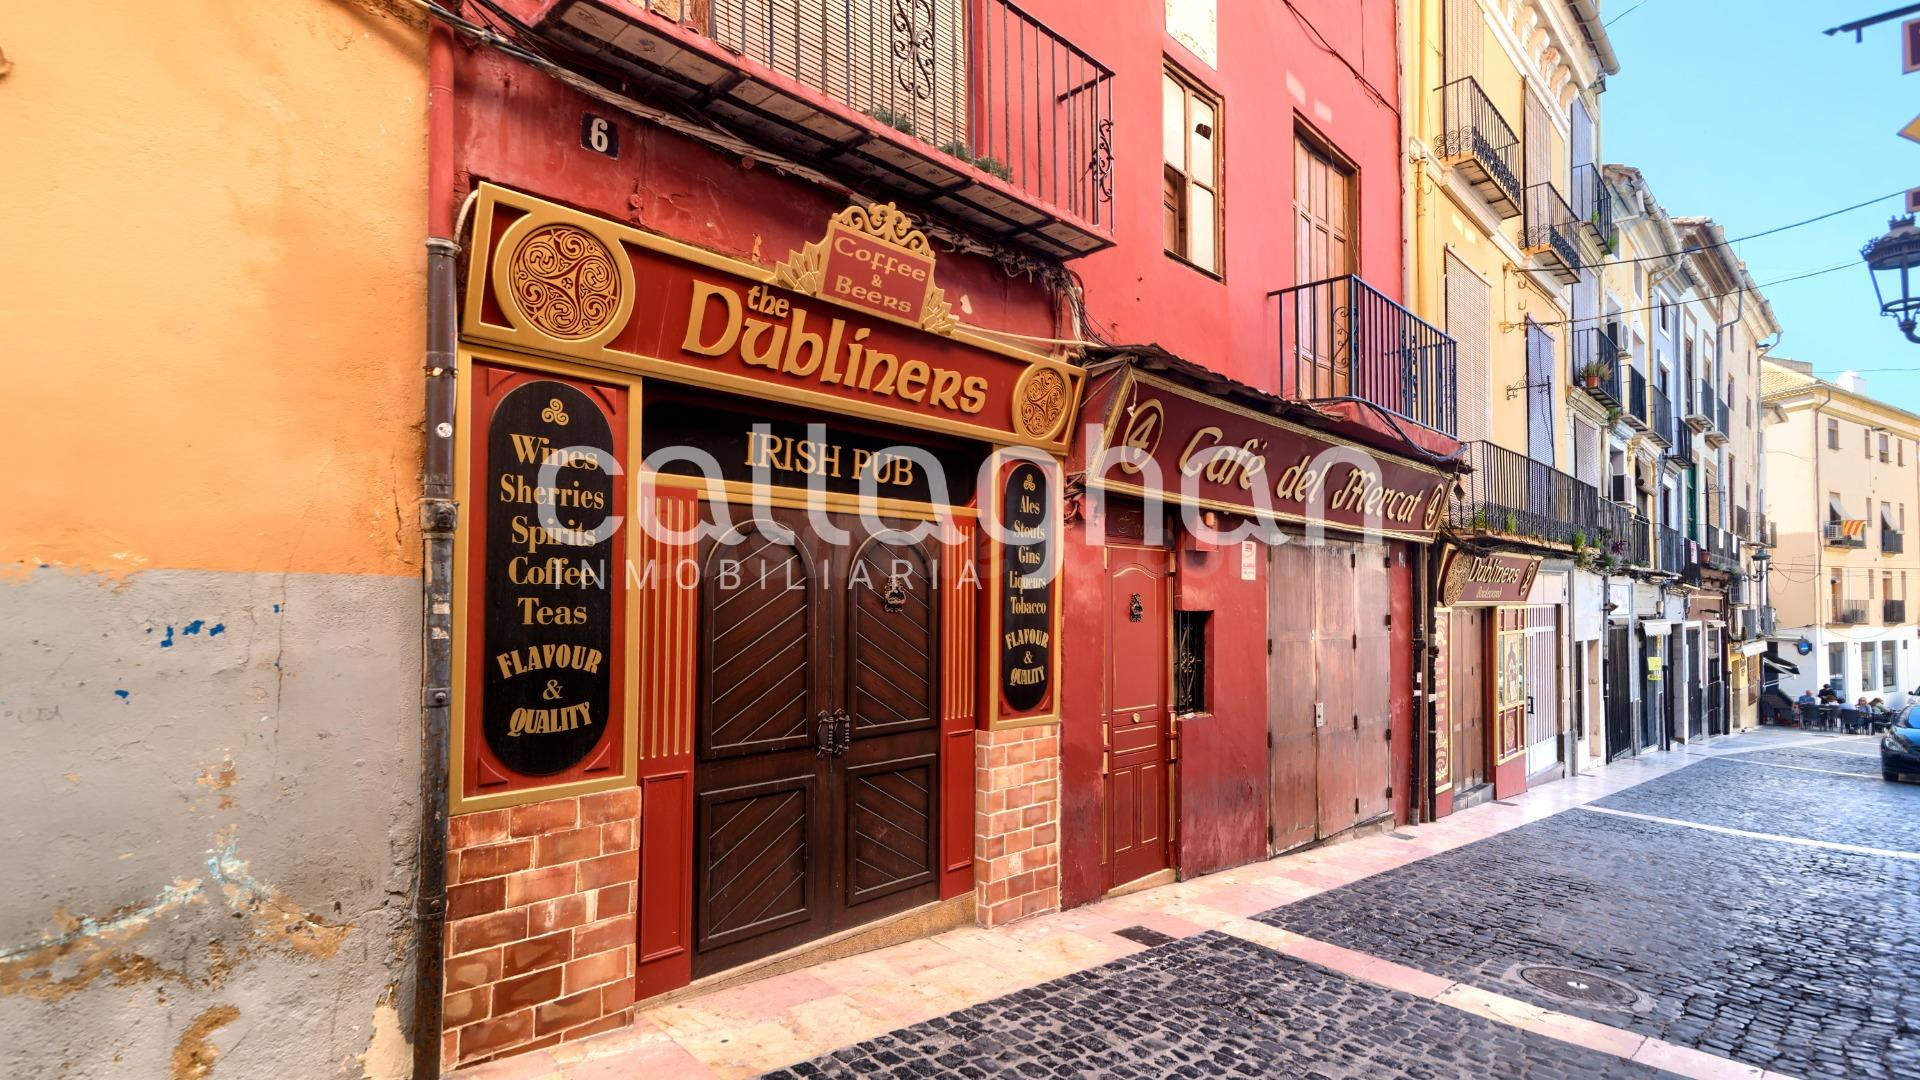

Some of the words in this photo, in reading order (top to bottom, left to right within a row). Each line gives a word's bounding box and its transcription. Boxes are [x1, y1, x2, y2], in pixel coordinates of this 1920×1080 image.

[590, 117, 609, 153] 6
[834, 236, 926, 282] Coffee
[834, 275, 912, 313] Beers
[871, 274, 882, 289] &
[747, 284, 790, 318] the
[682, 279, 989, 414] Dubliners
[510, 433, 599, 471] Wines
[745, 432, 842, 479] IRISH
[852, 449, 914, 487] PUB
[1128, 412, 1158, 460] 4
[1179, 426, 1268, 490] Café
[1276, 455, 1333, 504] del
[1332, 467, 1424, 523] Mercat
[500, 474, 604, 510] Sherries
[1020, 495, 1040, 514] Ales
[511, 515, 596, 553] Spirits
[1014, 520, 1046, 540] Stouts
[1018, 545, 1041, 564] Gins
[508, 557, 596, 586] Coffee
[1009, 570, 1047, 594] Liqueurs
[518, 597, 588, 625] Teas
[1010, 596, 1047, 615] Tobacco
[1005, 628, 1050, 650] FLAVOUR
[496, 644, 603, 679] FLAVOUR
[1023, 651, 1033, 664] &
[542, 680, 563, 700] &
[1010, 665, 1045, 686] QUALITY
[507, 702, 594, 736] QUALITY
